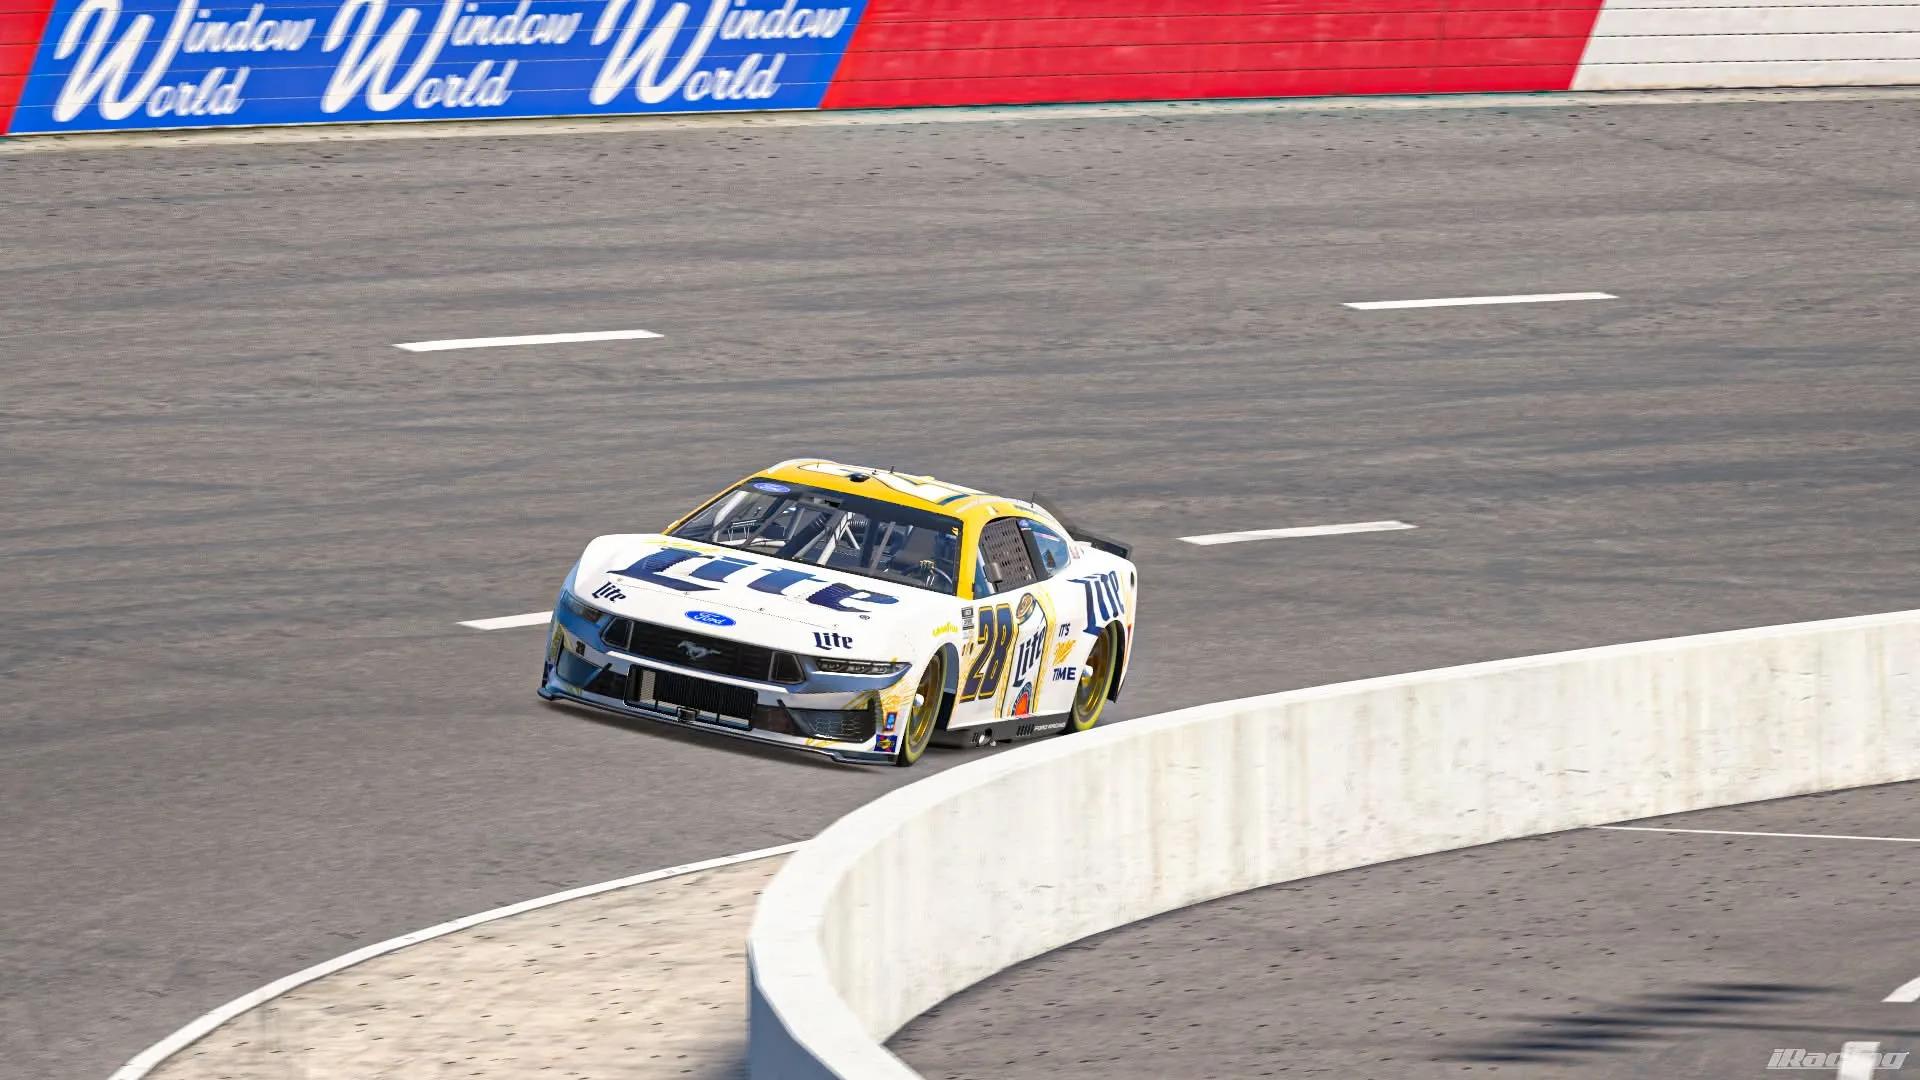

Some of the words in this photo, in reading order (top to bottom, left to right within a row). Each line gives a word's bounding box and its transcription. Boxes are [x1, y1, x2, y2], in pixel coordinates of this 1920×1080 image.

[606, 547, 900, 613] Lite
[591, 581, 627, 604] Lite
[692, 612, 728, 625] Ford
[813, 632, 853, 651] Lite
[959, 603, 1014, 704] 28
[1052, 667, 1077, 681] TIME
